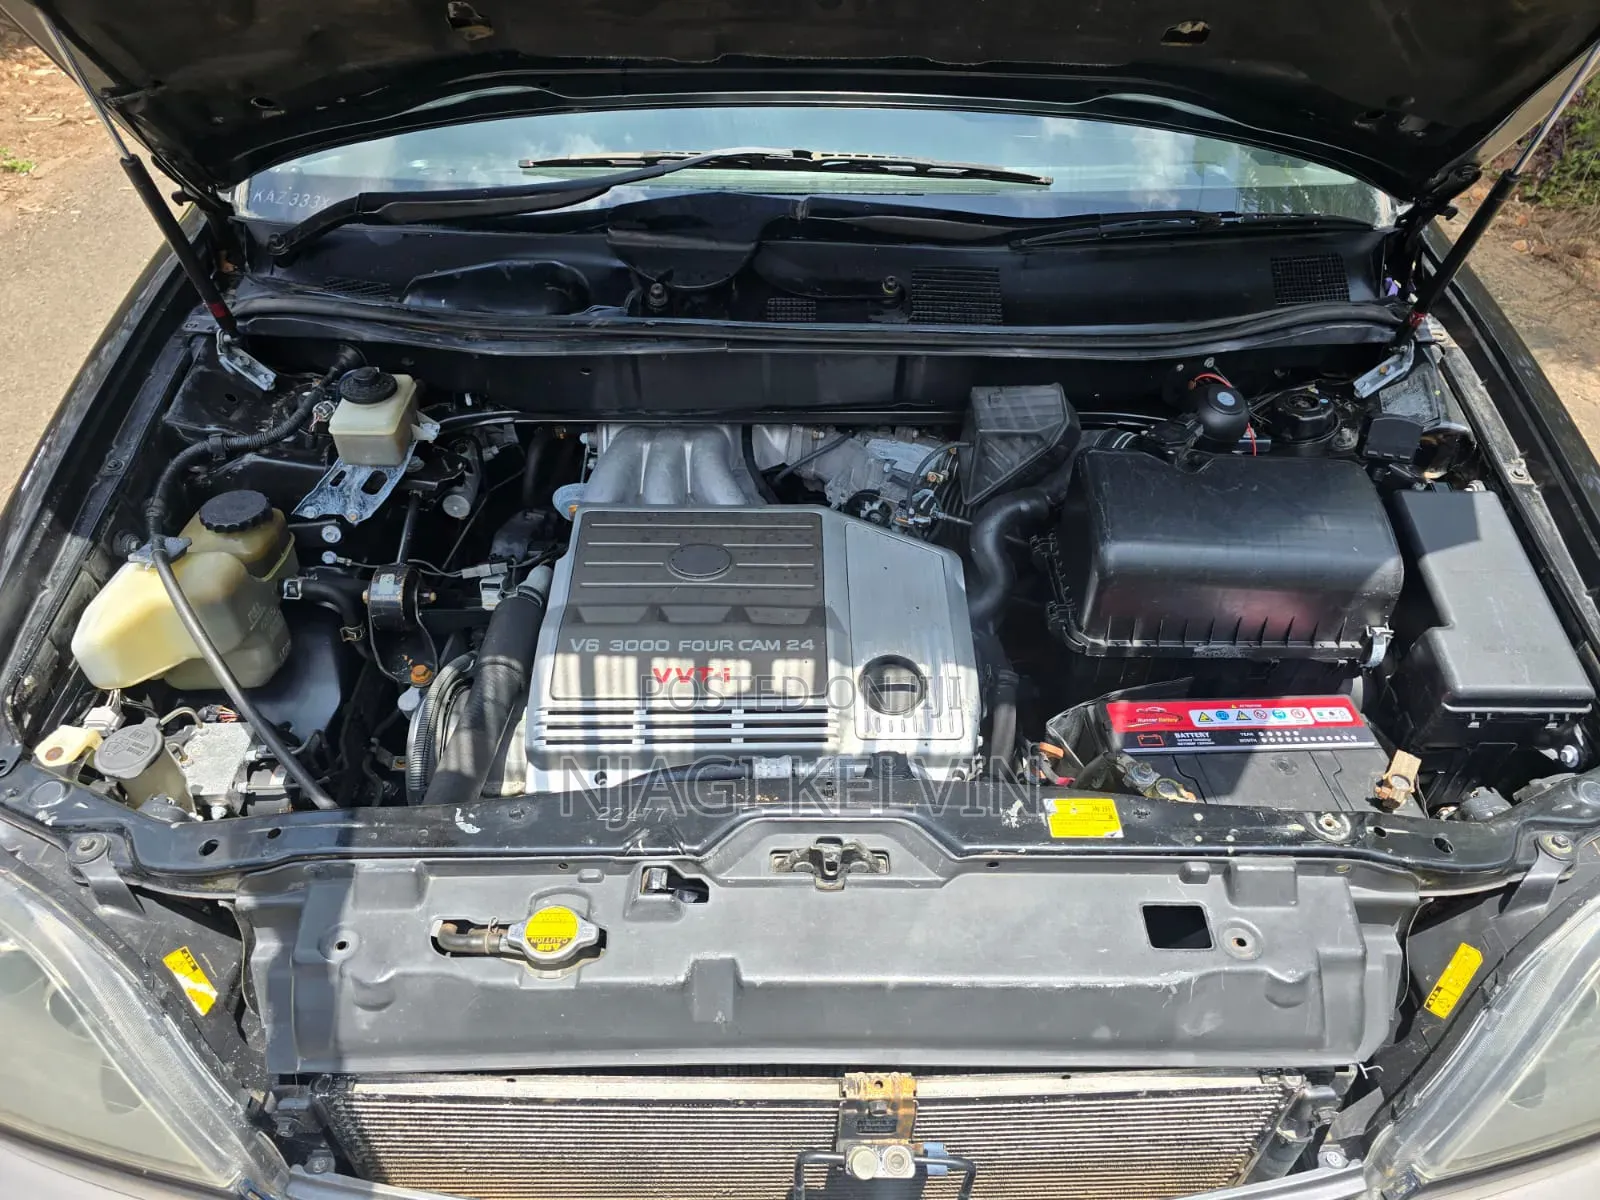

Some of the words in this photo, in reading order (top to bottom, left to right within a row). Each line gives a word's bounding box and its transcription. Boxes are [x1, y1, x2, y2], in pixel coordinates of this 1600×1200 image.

[570, 638, 600, 652] V6
[609, 639, 670, 652] 3000
[678, 639, 734, 652] FOUR
[738, 639, 781, 652] CAM
[786, 639, 815, 652] 24
